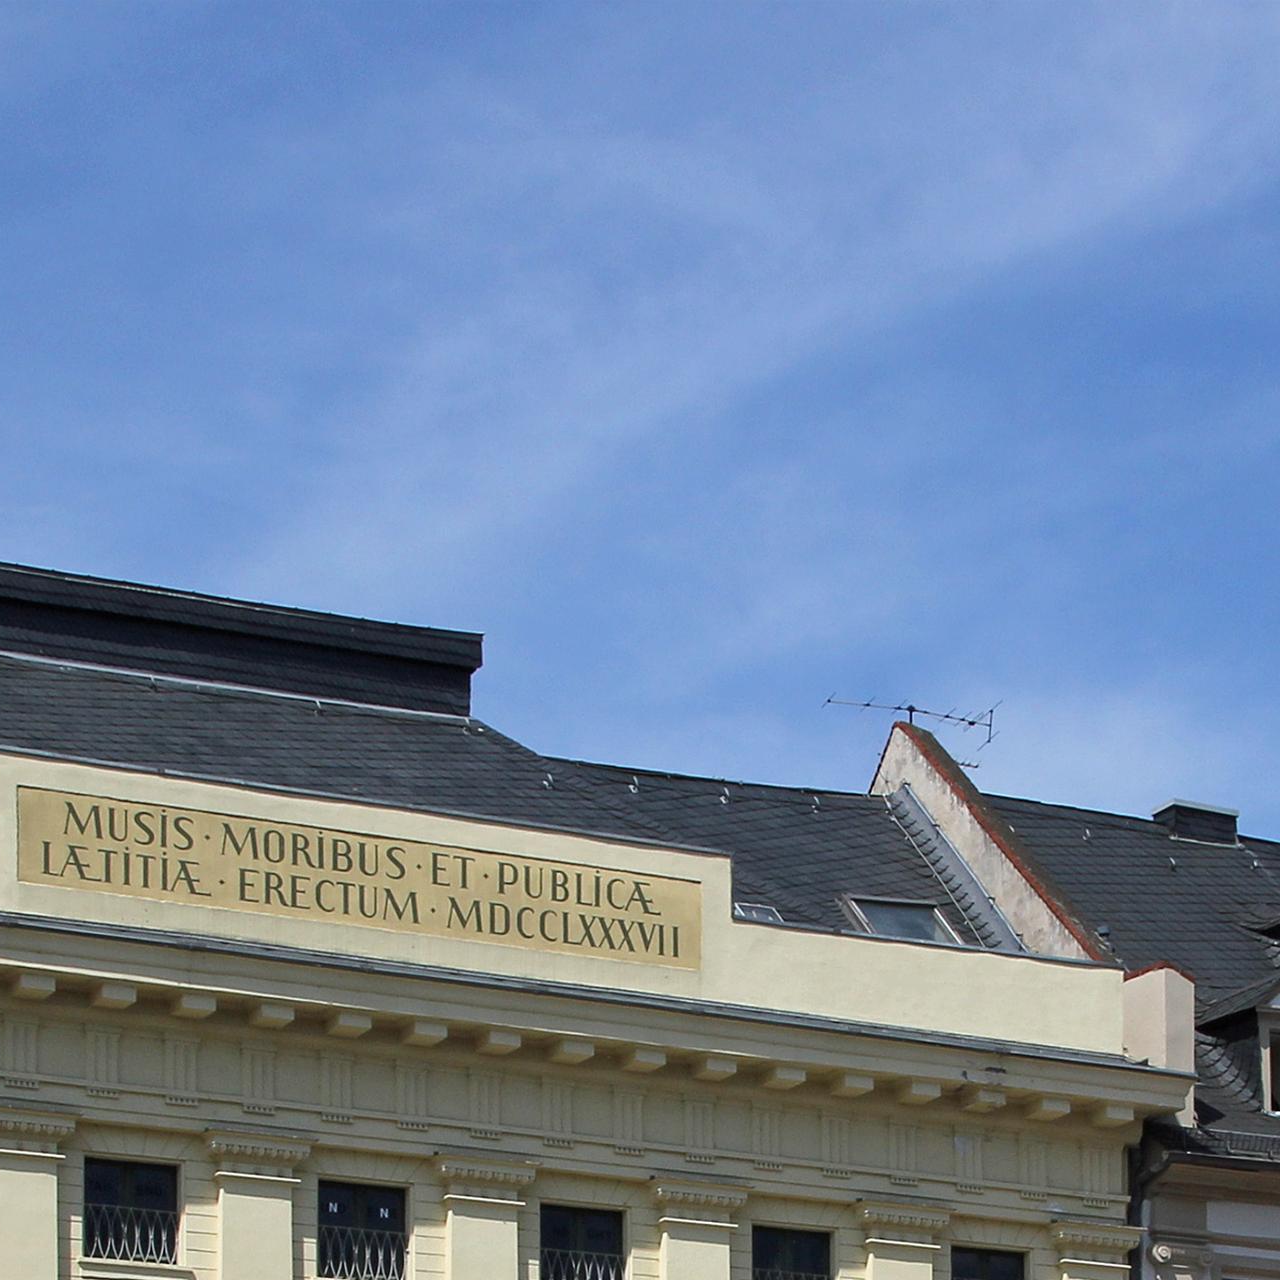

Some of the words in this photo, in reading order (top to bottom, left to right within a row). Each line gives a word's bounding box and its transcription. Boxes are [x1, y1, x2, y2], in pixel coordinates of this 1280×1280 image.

[63, 801, 195, 851] MUSIS
[220, 822, 407, 881] MORIBUS
[431, 852, 476, 890] ET
[238, 867, 421, 924] ERECTUM
[446, 896, 680, 958] MDCCLXXXVII
